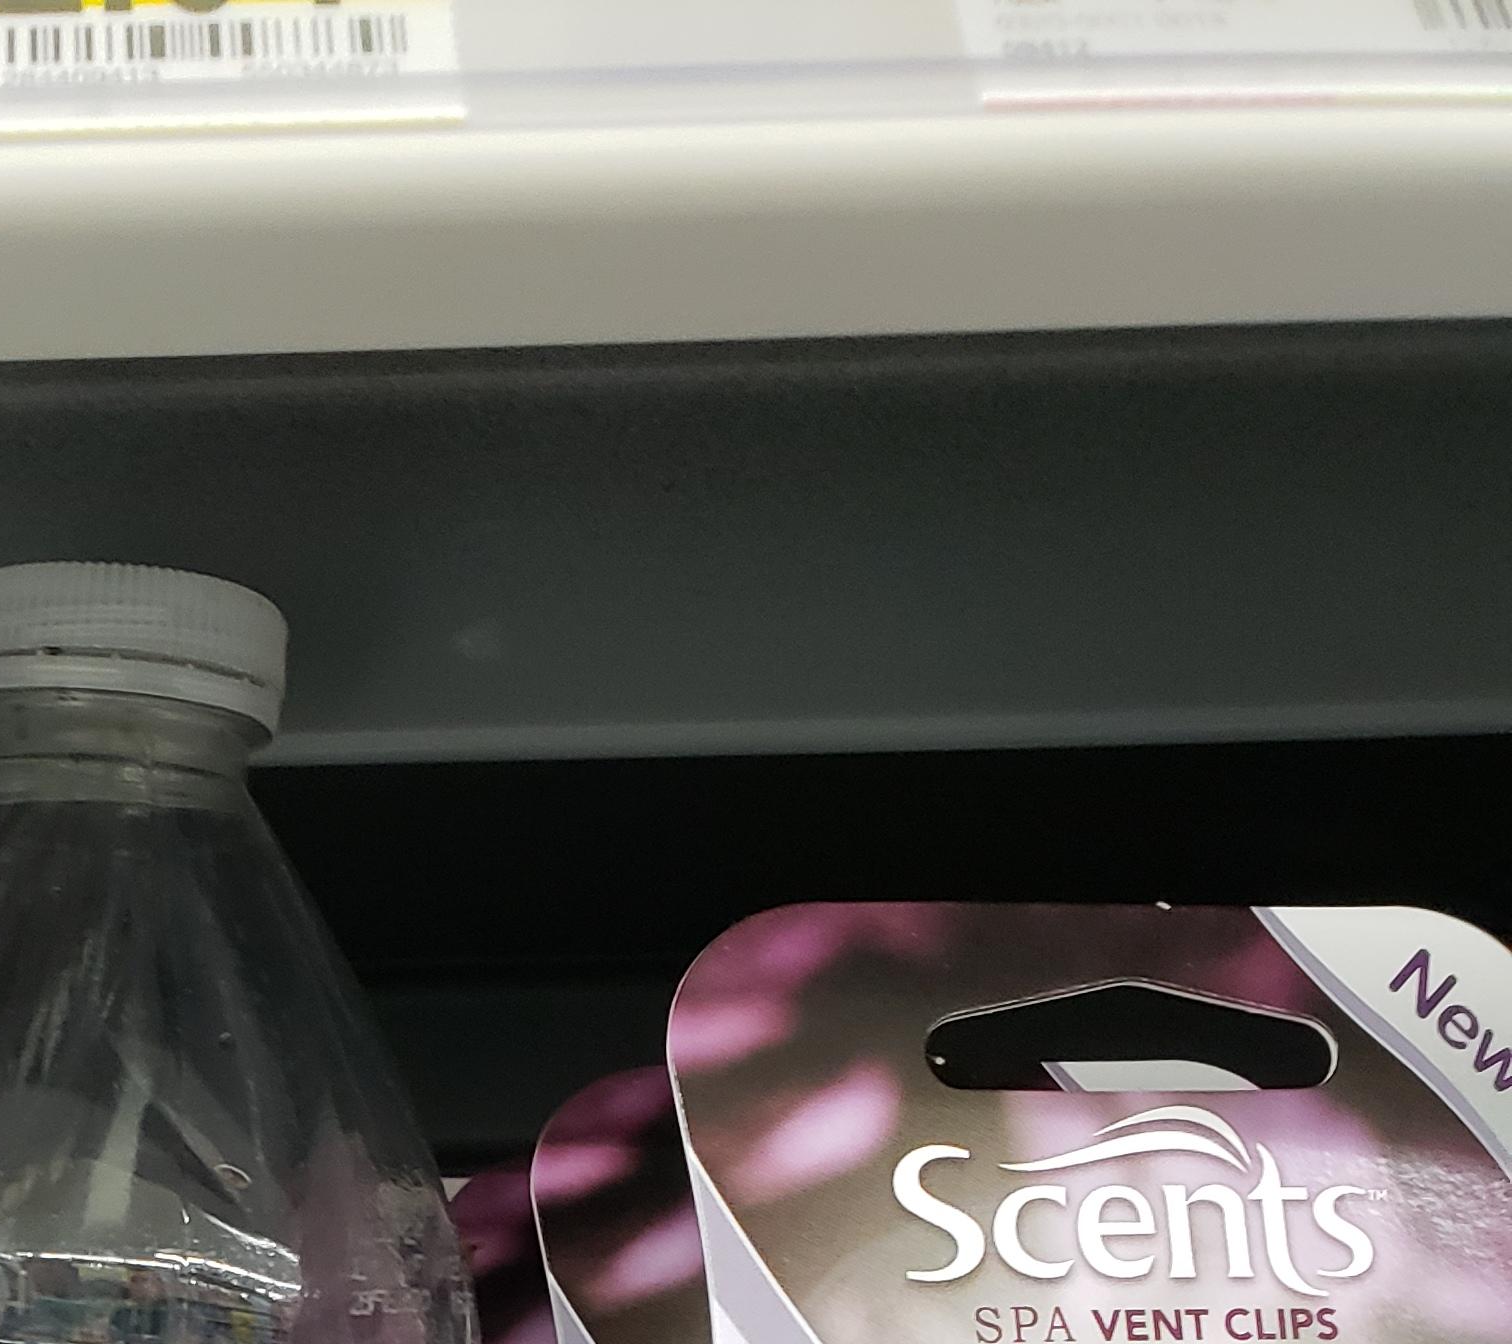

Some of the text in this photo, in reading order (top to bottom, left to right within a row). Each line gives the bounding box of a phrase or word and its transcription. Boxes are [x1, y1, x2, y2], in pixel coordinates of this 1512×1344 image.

[892, 1142, 1375, 1297] Scents
[974, 1305, 1340, 1344] SPA VENT CLIPS
